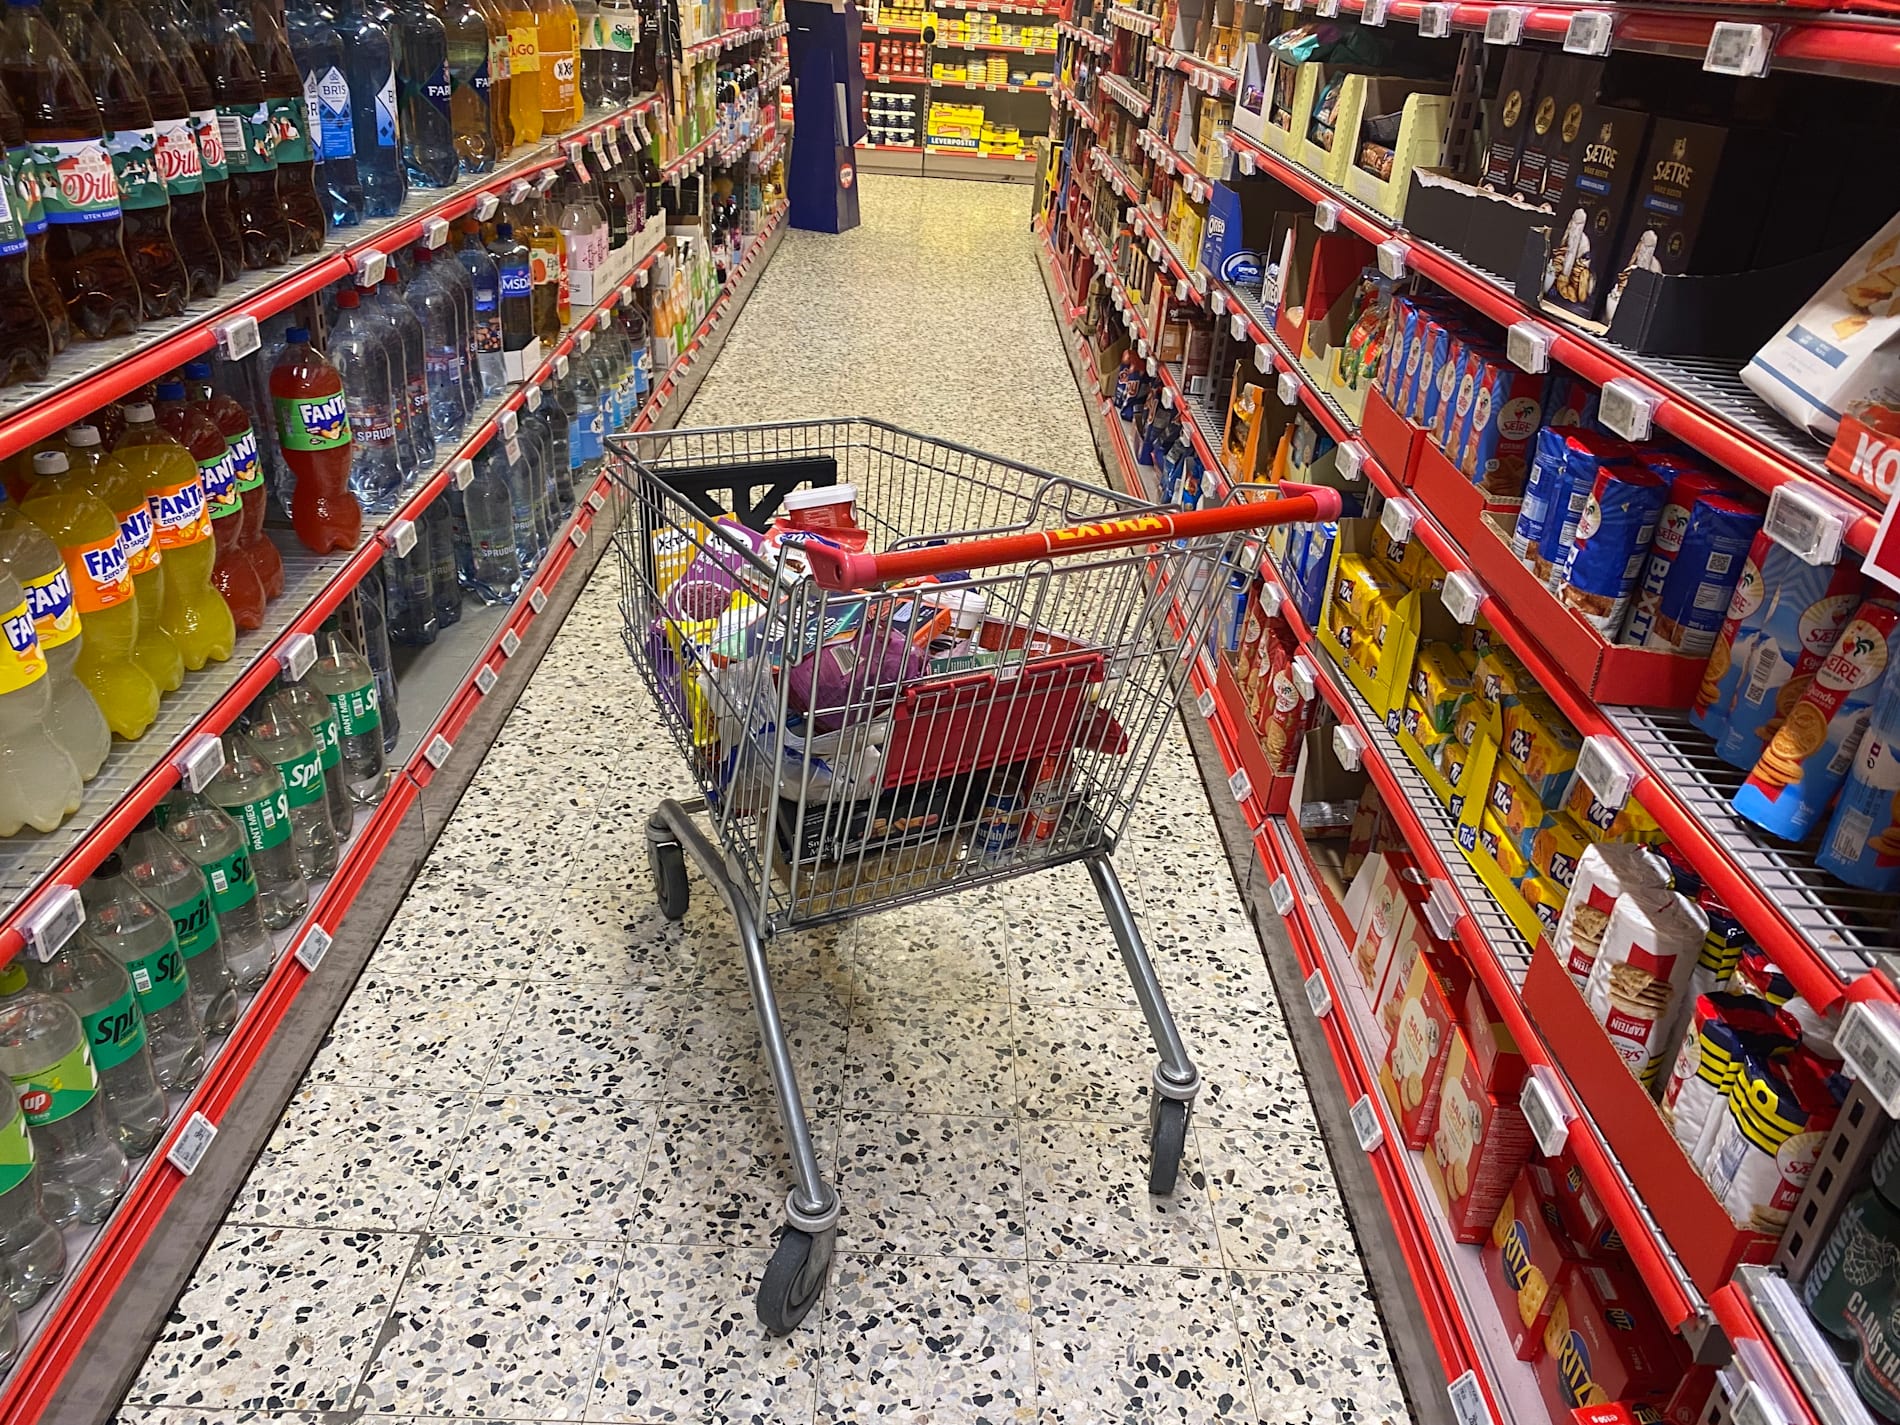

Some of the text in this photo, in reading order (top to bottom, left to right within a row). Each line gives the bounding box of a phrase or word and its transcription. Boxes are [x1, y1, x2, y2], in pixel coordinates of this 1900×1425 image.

[323, 85, 346, 95] BRIS
[931, 137, 976, 147] LEVERPOSTEI
[1583, 143, 1618, 170] SÆTRE
[1652, 160, 1694, 189] SÆTRE
[162, 515, 182, 525] zero
[1511, 730, 1529, 761] TUC
[1493, 782, 1512, 814] TUC
[244, 804, 264, 851] PANT MEG
[1459, 827, 1475, 850] TUC
[1551, 853, 1574, 889] TUC
[1611, 1018, 1646, 1037] KAPTEIN
[24, 1093, 46, 1111] up
[1503, 1227, 1531, 1291] RITZ
[1608, 1308, 1632, 1331] RITZ
[1559, 1332, 1593, 1408] RITZ
